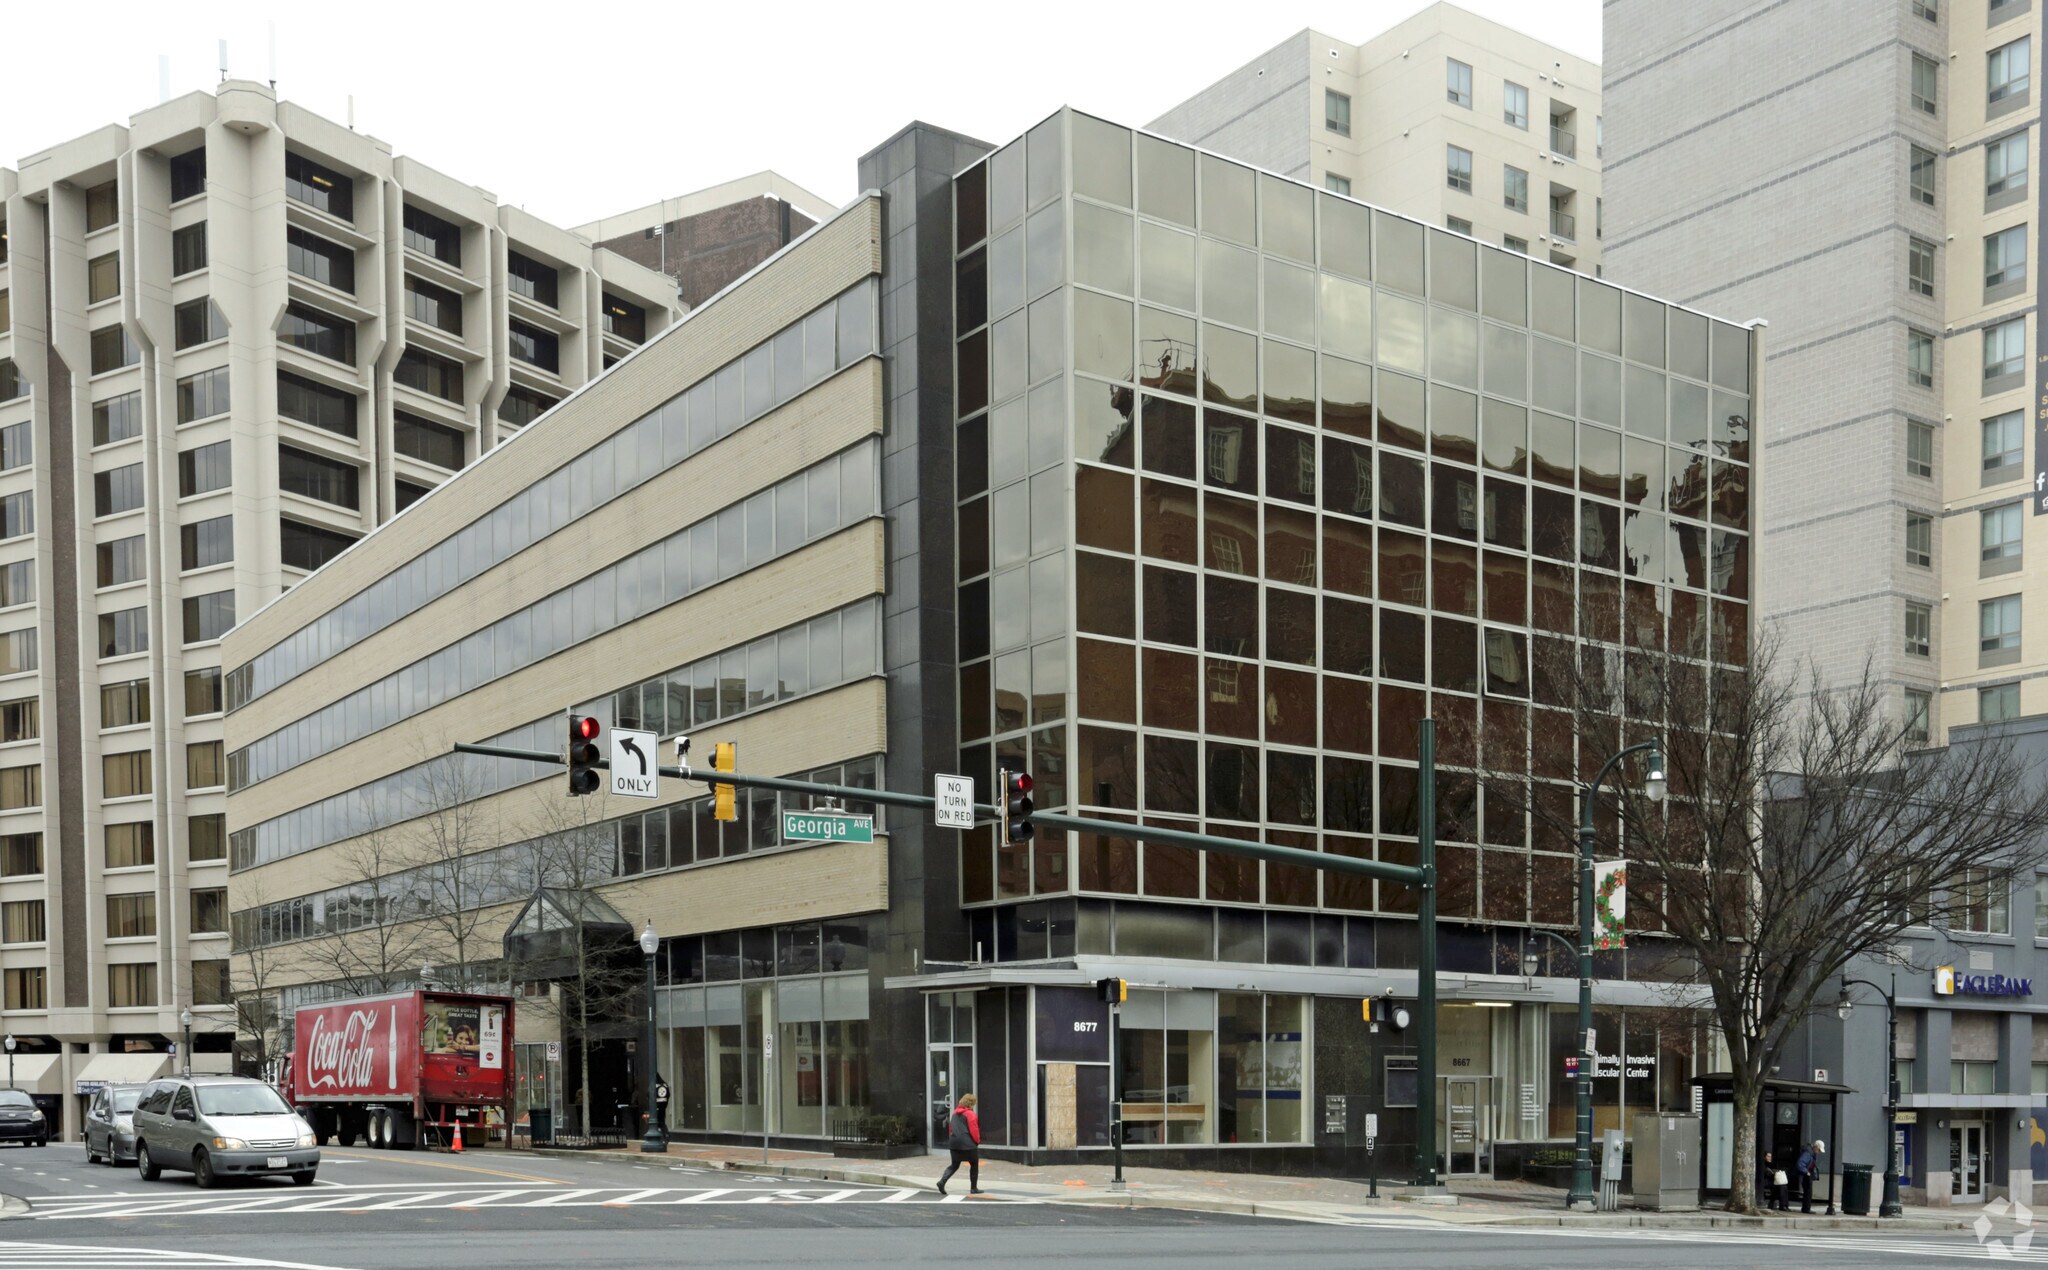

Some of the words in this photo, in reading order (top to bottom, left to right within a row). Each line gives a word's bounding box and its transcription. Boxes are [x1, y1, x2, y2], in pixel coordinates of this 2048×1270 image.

[617, 777, 652, 792] ONLY
[947, 782, 962, 793] NO
[943, 795, 967, 807] TURN
[938, 809, 950, 820] ON
[954, 810, 972, 822] RED
[787, 816, 846, 839] Georgia
[853, 819, 869, 829] AVE
[1073, 1021, 1098, 1032] 8677
[1452, 1057, 1471, 1067] 8667
[1626, 1054, 1655, 1065] Invasive
[1626, 1067, 1649, 1077] Center
